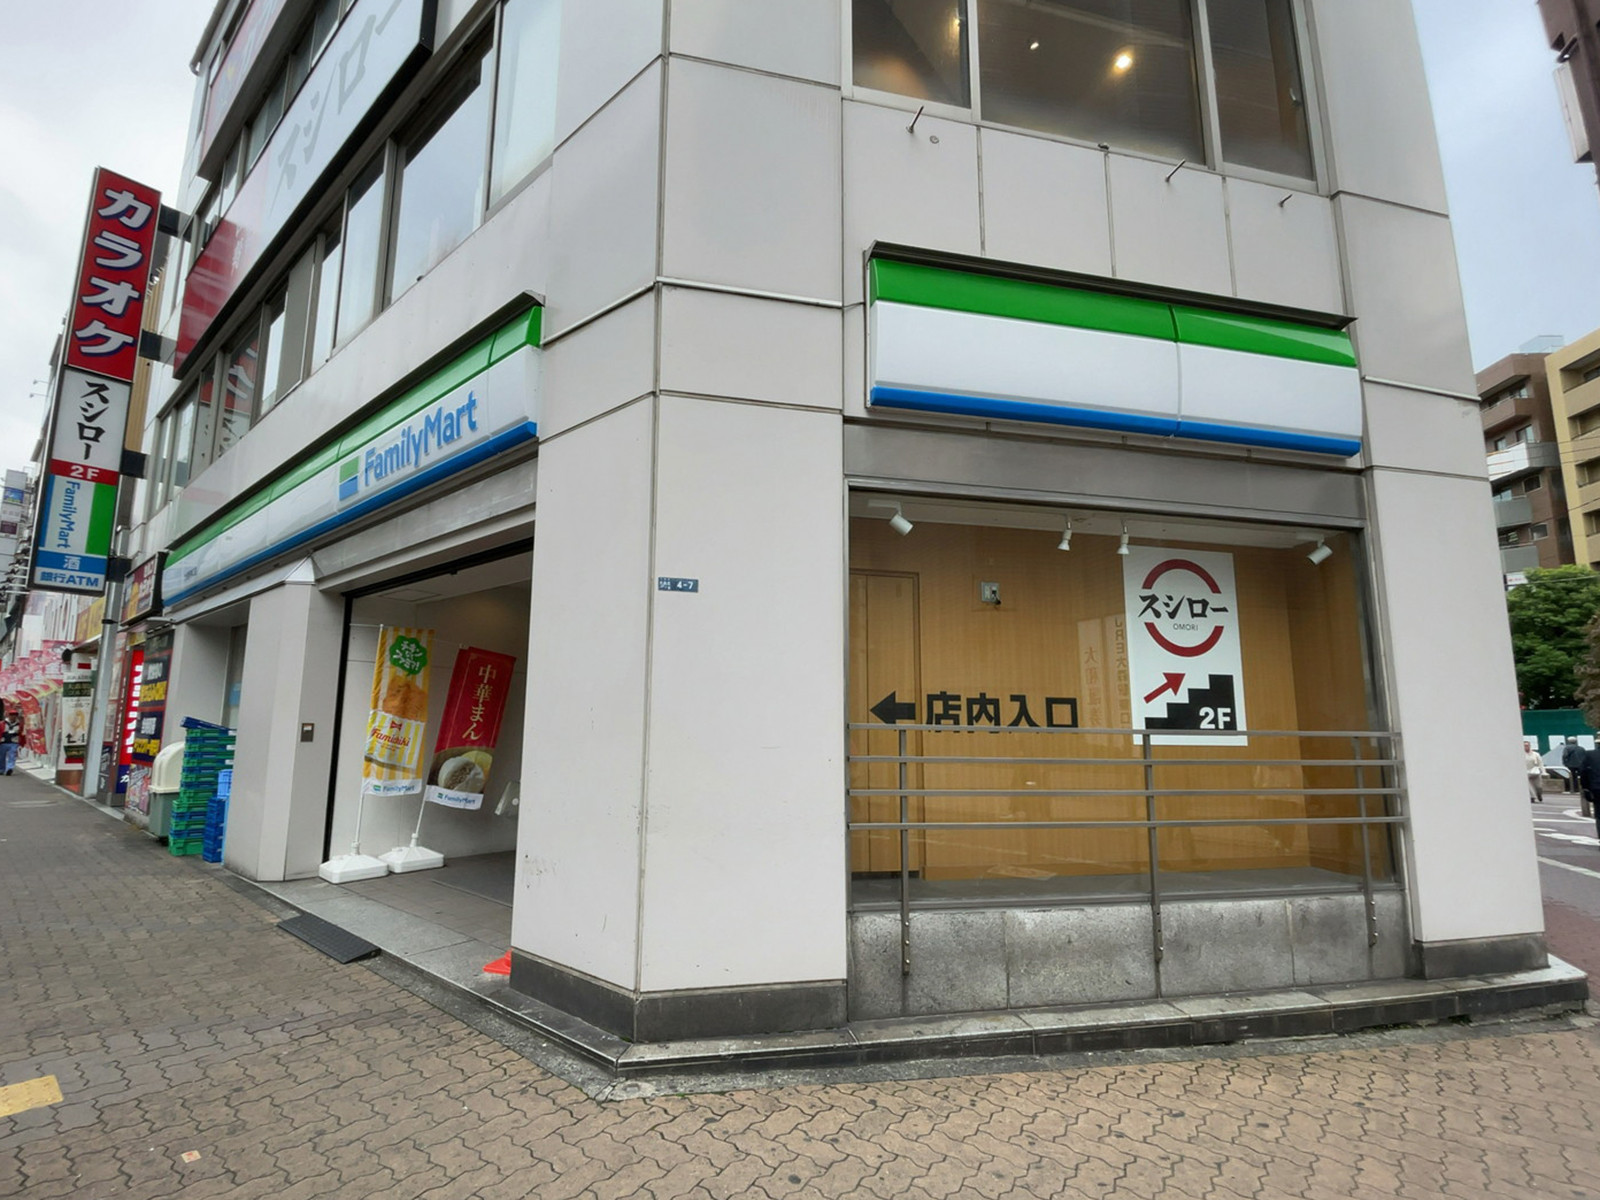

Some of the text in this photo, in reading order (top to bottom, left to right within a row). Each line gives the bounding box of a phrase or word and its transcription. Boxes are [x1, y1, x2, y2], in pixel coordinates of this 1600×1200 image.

[74, 188, 153, 356] カラオケ
[76, 380, 112, 460] スシロー
[364, 390, 478, 483] FamilyMart
[70, 464, 99, 481] 2F
[57, 480, 81, 549] FamilyMart
[63, 555, 81, 571] 酒
[39, 570, 100, 588] 銀行ATM
[1138, 593, 1229, 621] スシロー
[1172, 623, 1199, 632] OMORI
[462, 664, 497, 740] 中華まん
[925, 690, 1079, 733] 店内入口
[1198, 705, 1232, 730] 2F
[382, 784, 415, 793] FamilyMart
[444, 795, 476, 805] FamilyMart
